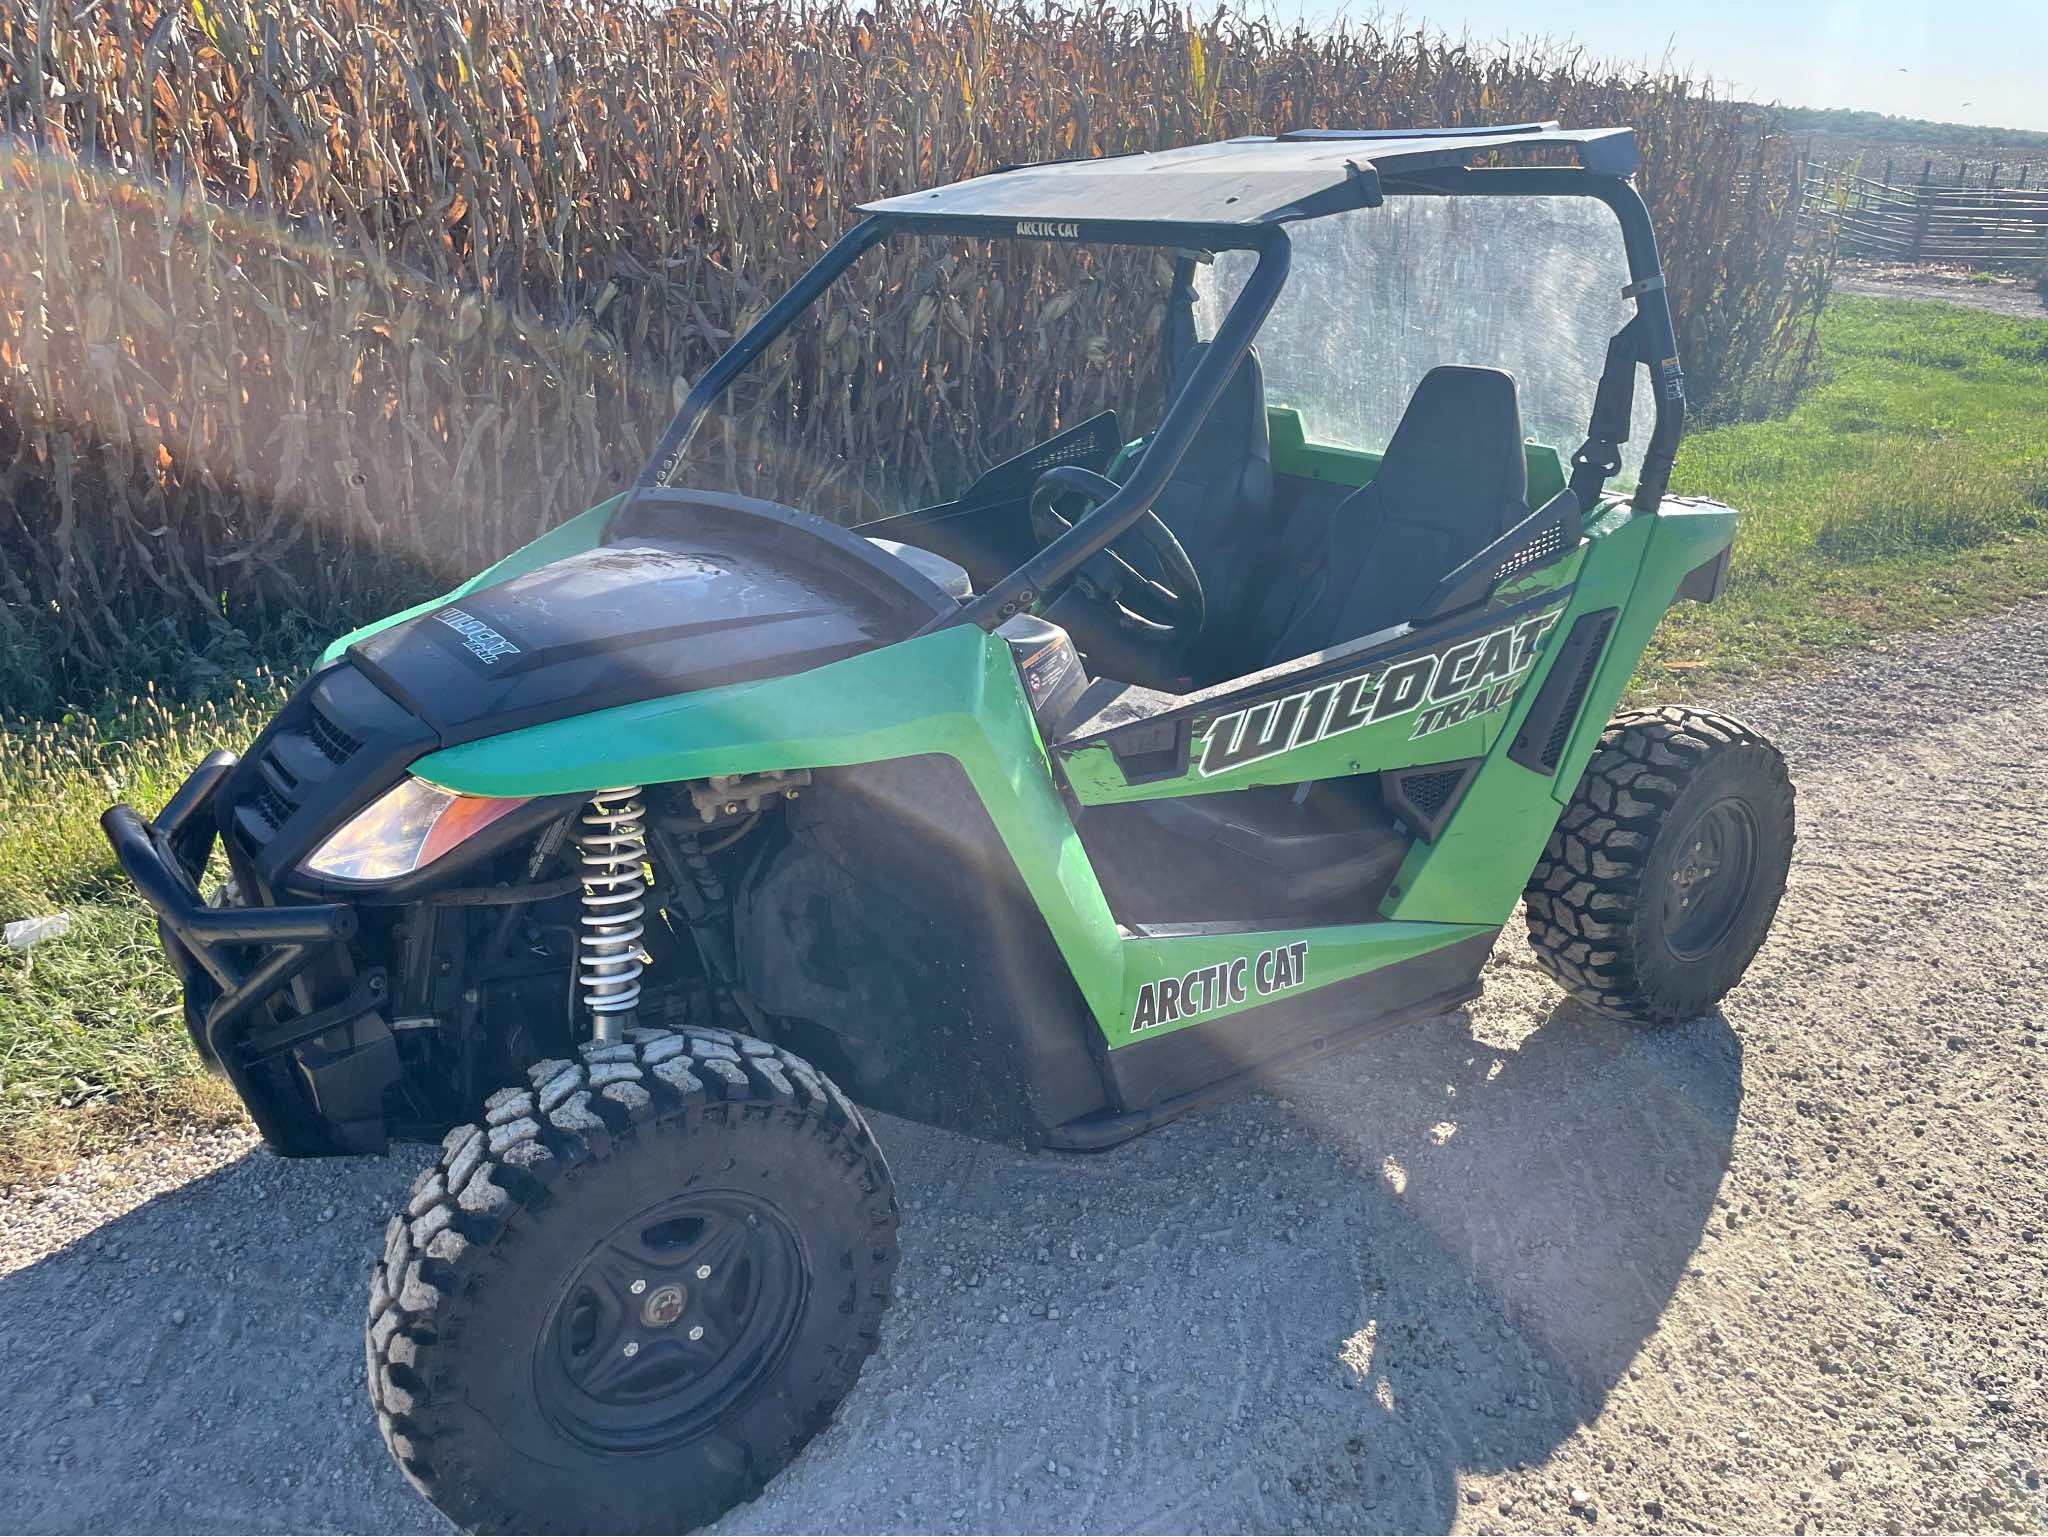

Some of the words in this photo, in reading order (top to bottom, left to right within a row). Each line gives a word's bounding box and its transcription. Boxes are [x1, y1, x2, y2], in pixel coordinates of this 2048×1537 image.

[1016, 221, 1056, 237] ARCTIC
[1057, 223, 1080, 238] CAT
[432, 607, 521, 656] WILDCAT
[1199, 608, 1563, 777] WILDCAT
[1408, 673, 1521, 741] TRAIL
[1130, 957, 1247, 1033] ARCTIC
[1255, 940, 1308, 996] CAT
